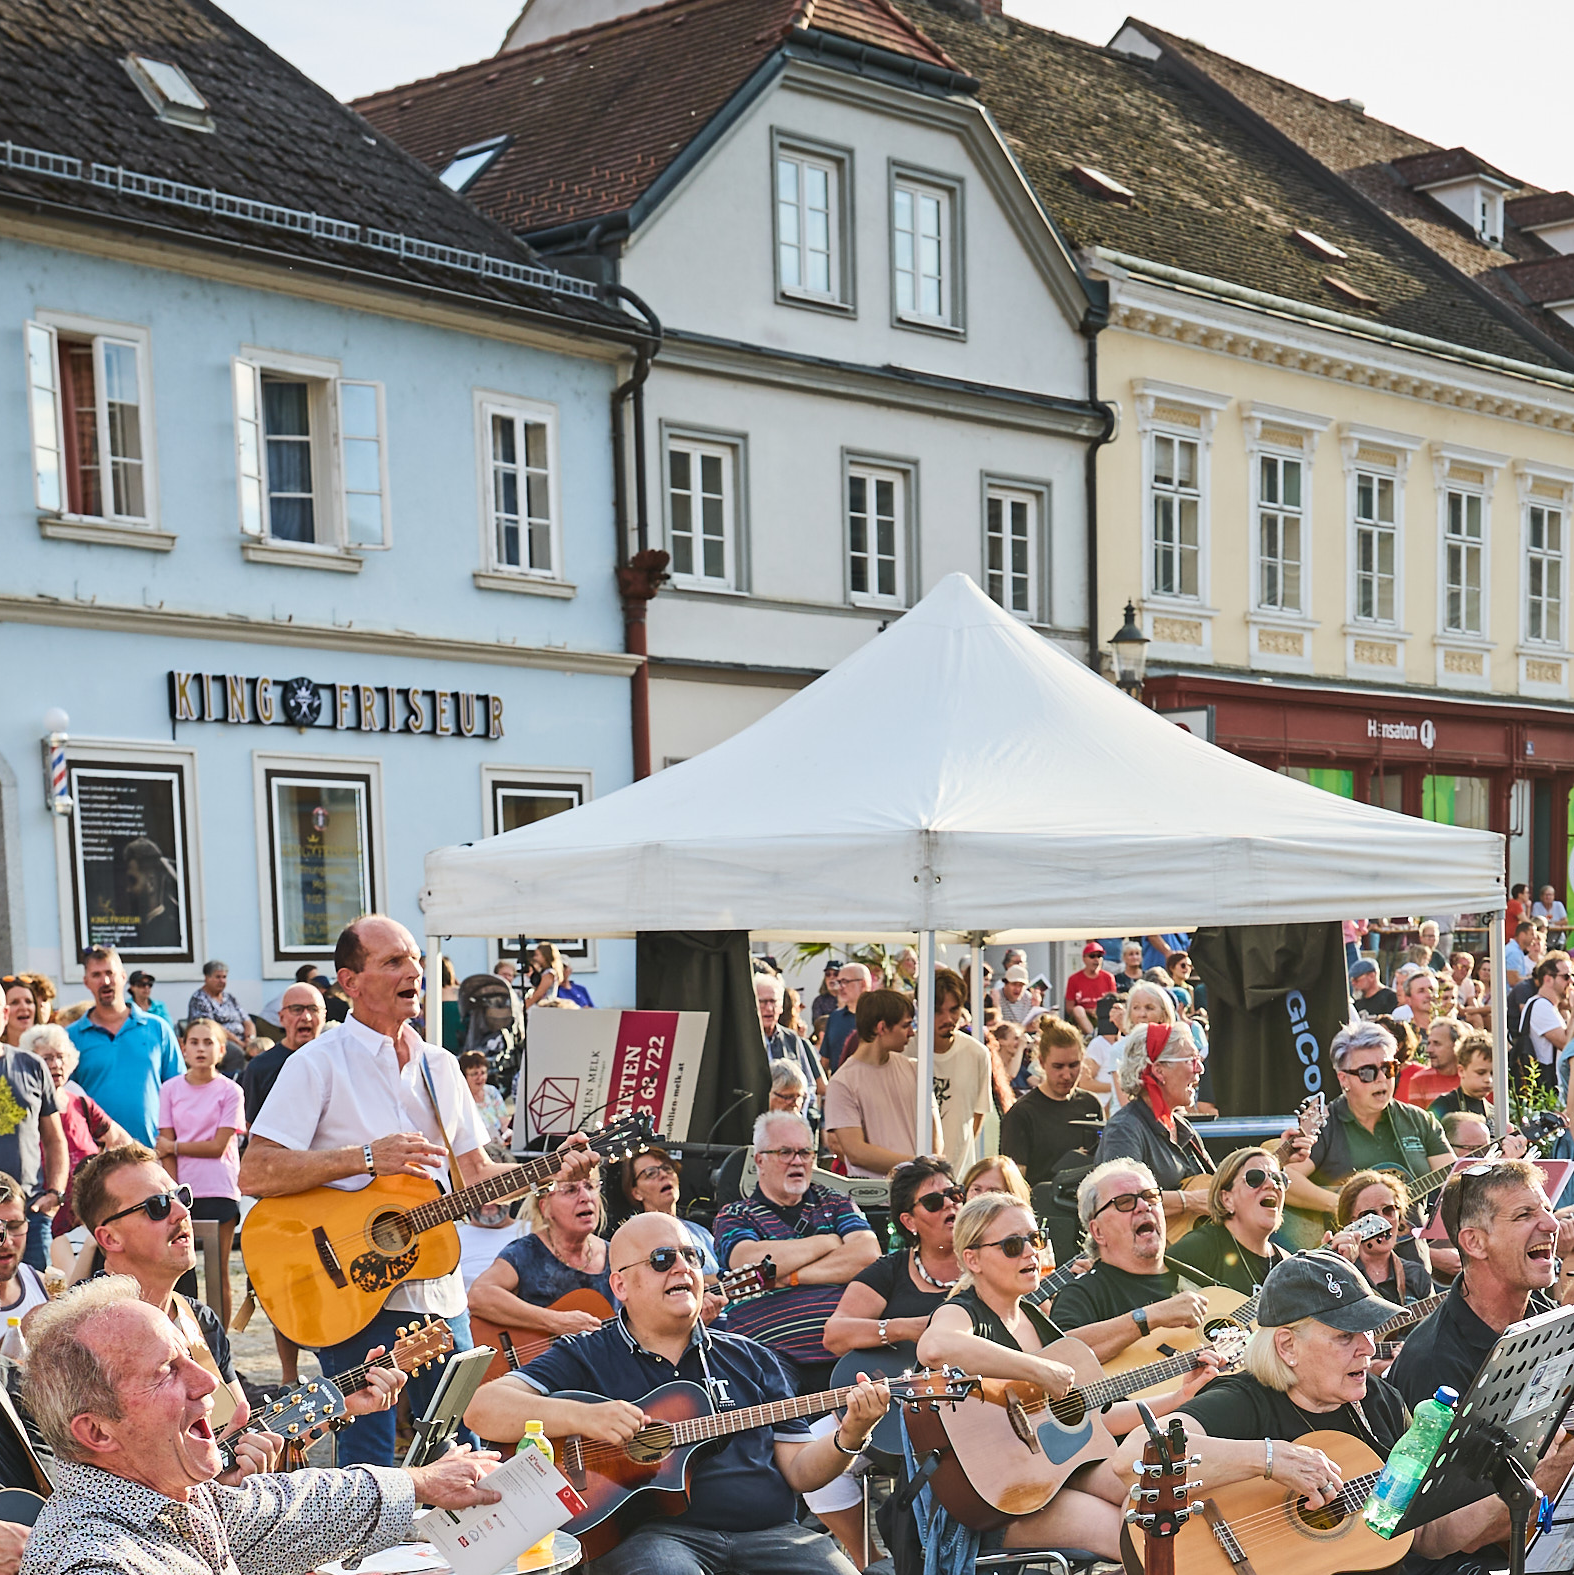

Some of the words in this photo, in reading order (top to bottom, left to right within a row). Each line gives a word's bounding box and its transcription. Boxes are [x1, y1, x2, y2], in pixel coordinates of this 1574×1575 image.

[175, 671, 274, 725] KING
[335, 681, 506, 739] FRISEUR
[588, 1050, 601, 1083] MELK
[645, 1035, 666, 1072] 722
